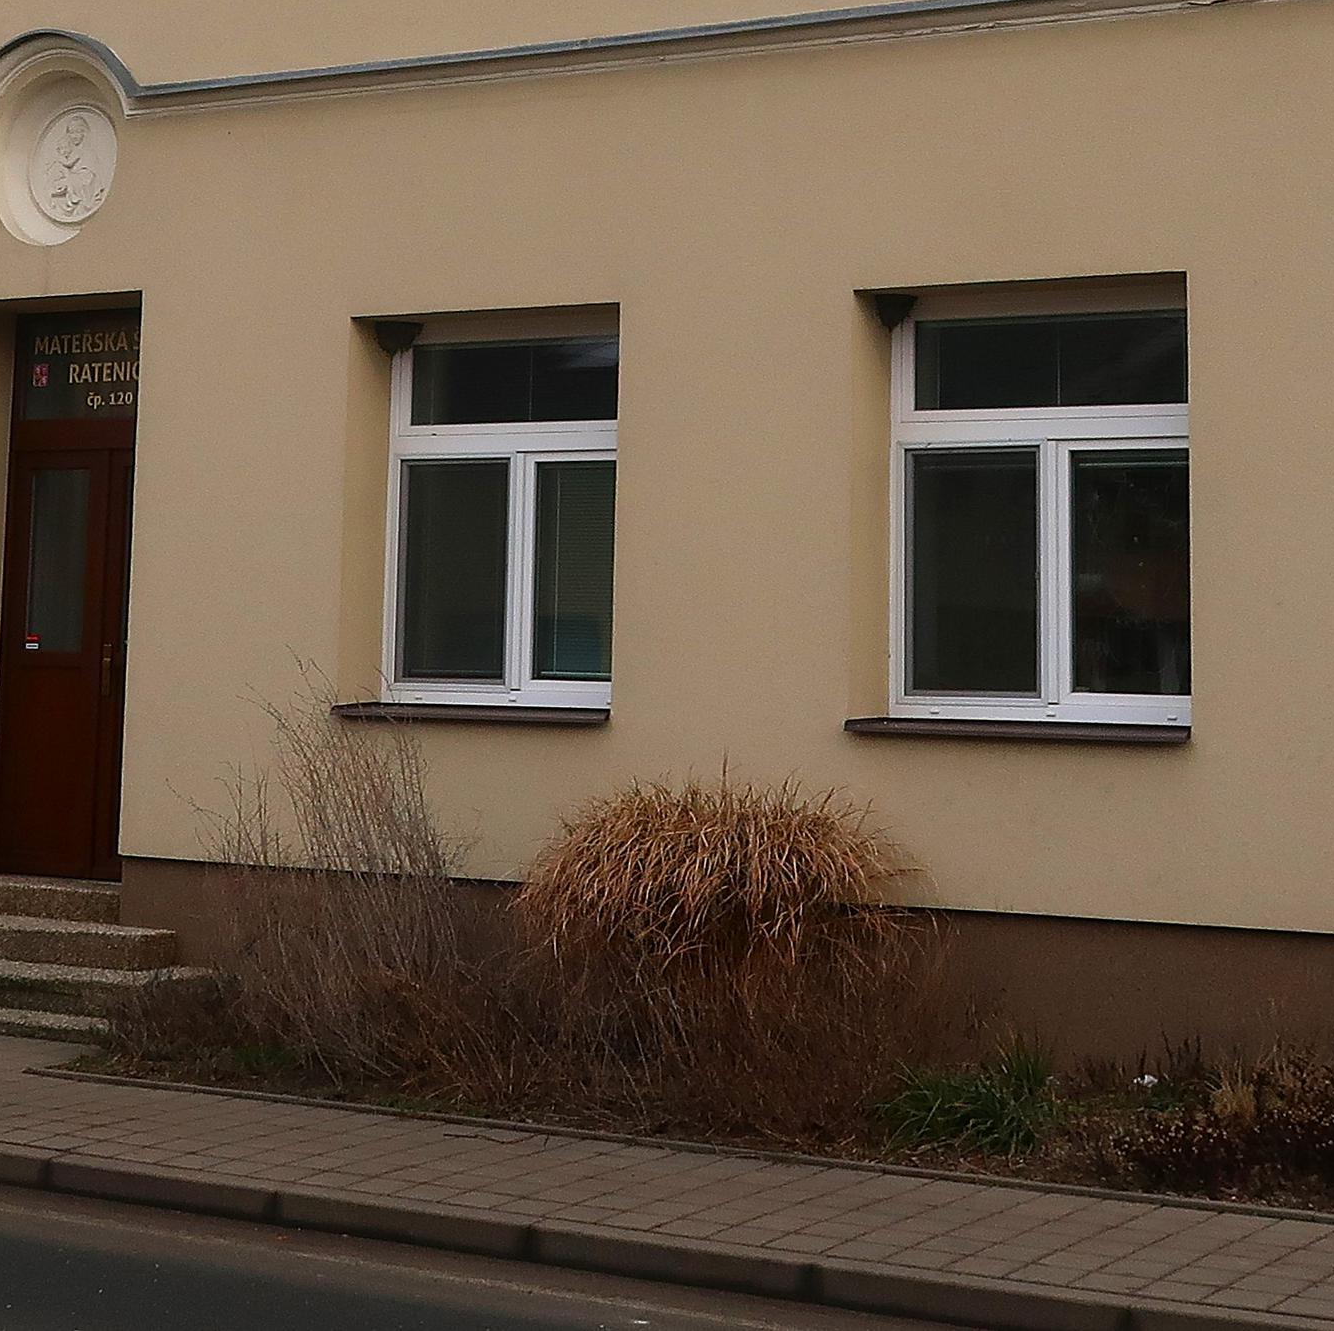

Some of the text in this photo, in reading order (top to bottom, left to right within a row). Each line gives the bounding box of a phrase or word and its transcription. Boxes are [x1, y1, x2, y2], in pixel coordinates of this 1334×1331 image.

[34, 328, 128, 355] MATEŘSKÁ
[87, 391, 133, 410] čp. 120
